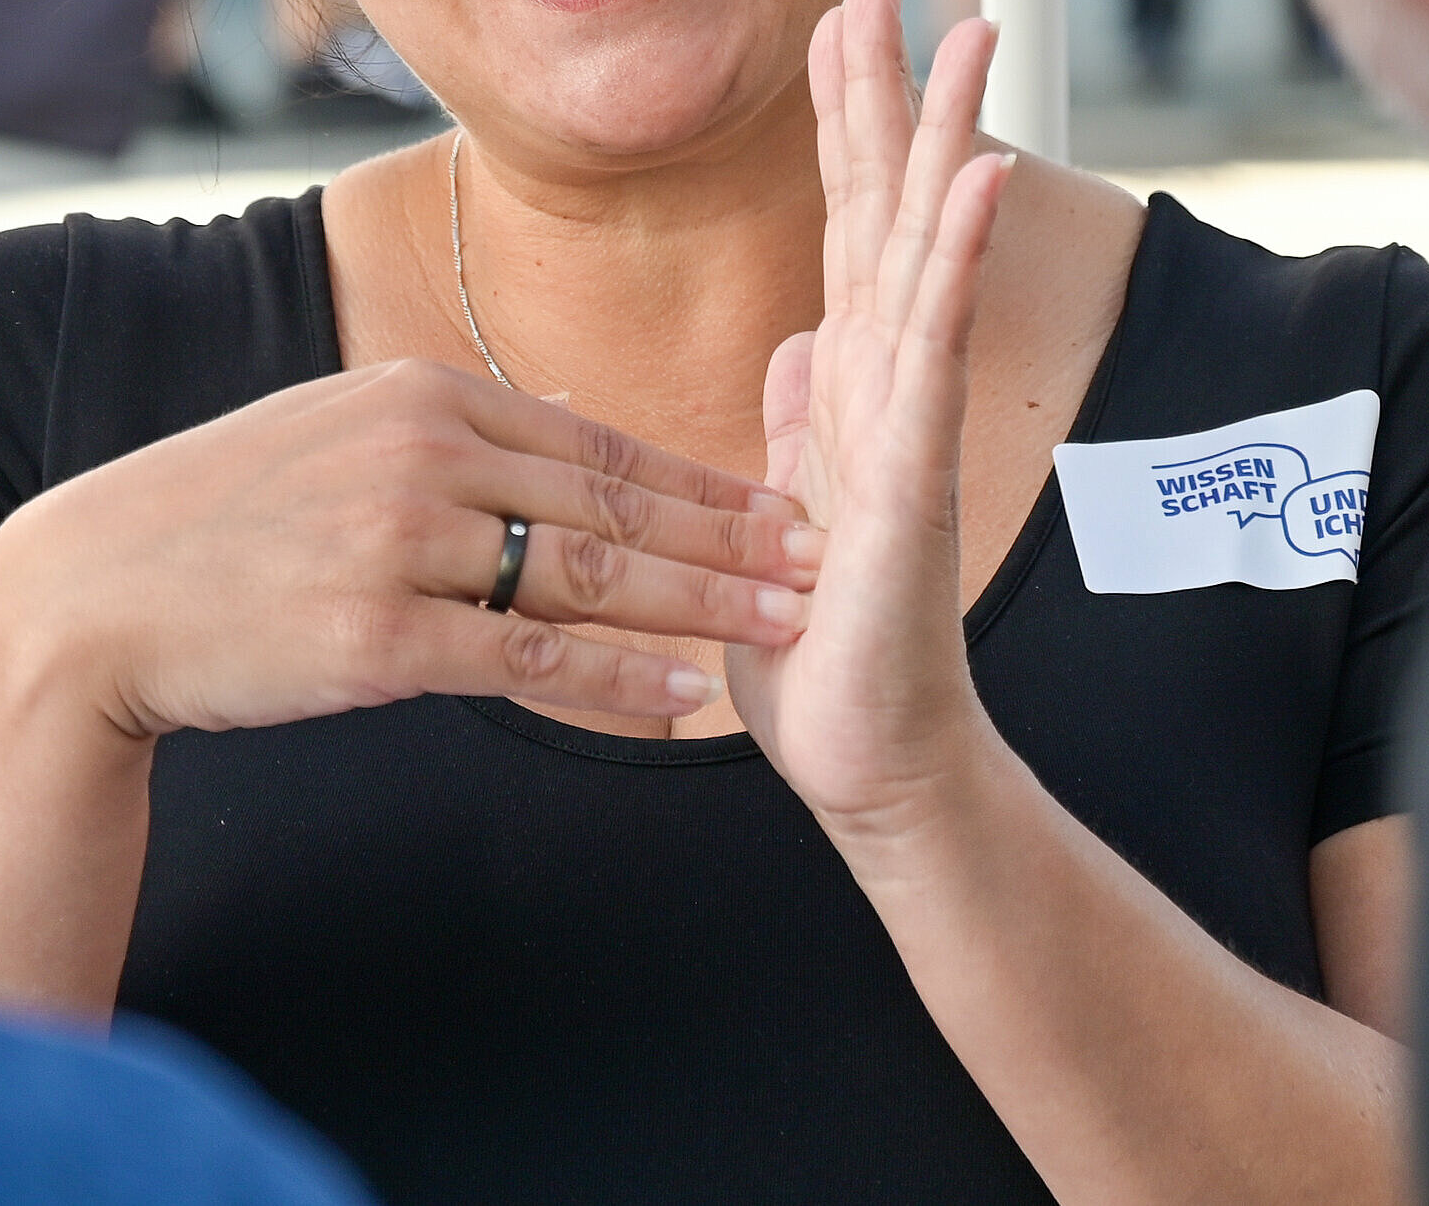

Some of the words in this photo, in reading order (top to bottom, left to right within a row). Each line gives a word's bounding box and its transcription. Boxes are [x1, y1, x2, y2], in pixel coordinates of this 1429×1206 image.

[1156, 458, 1275, 496] WISSEN
[1160, 481, 1277, 517] SCHAFT
[1314, 513, 1366, 539] ICH
